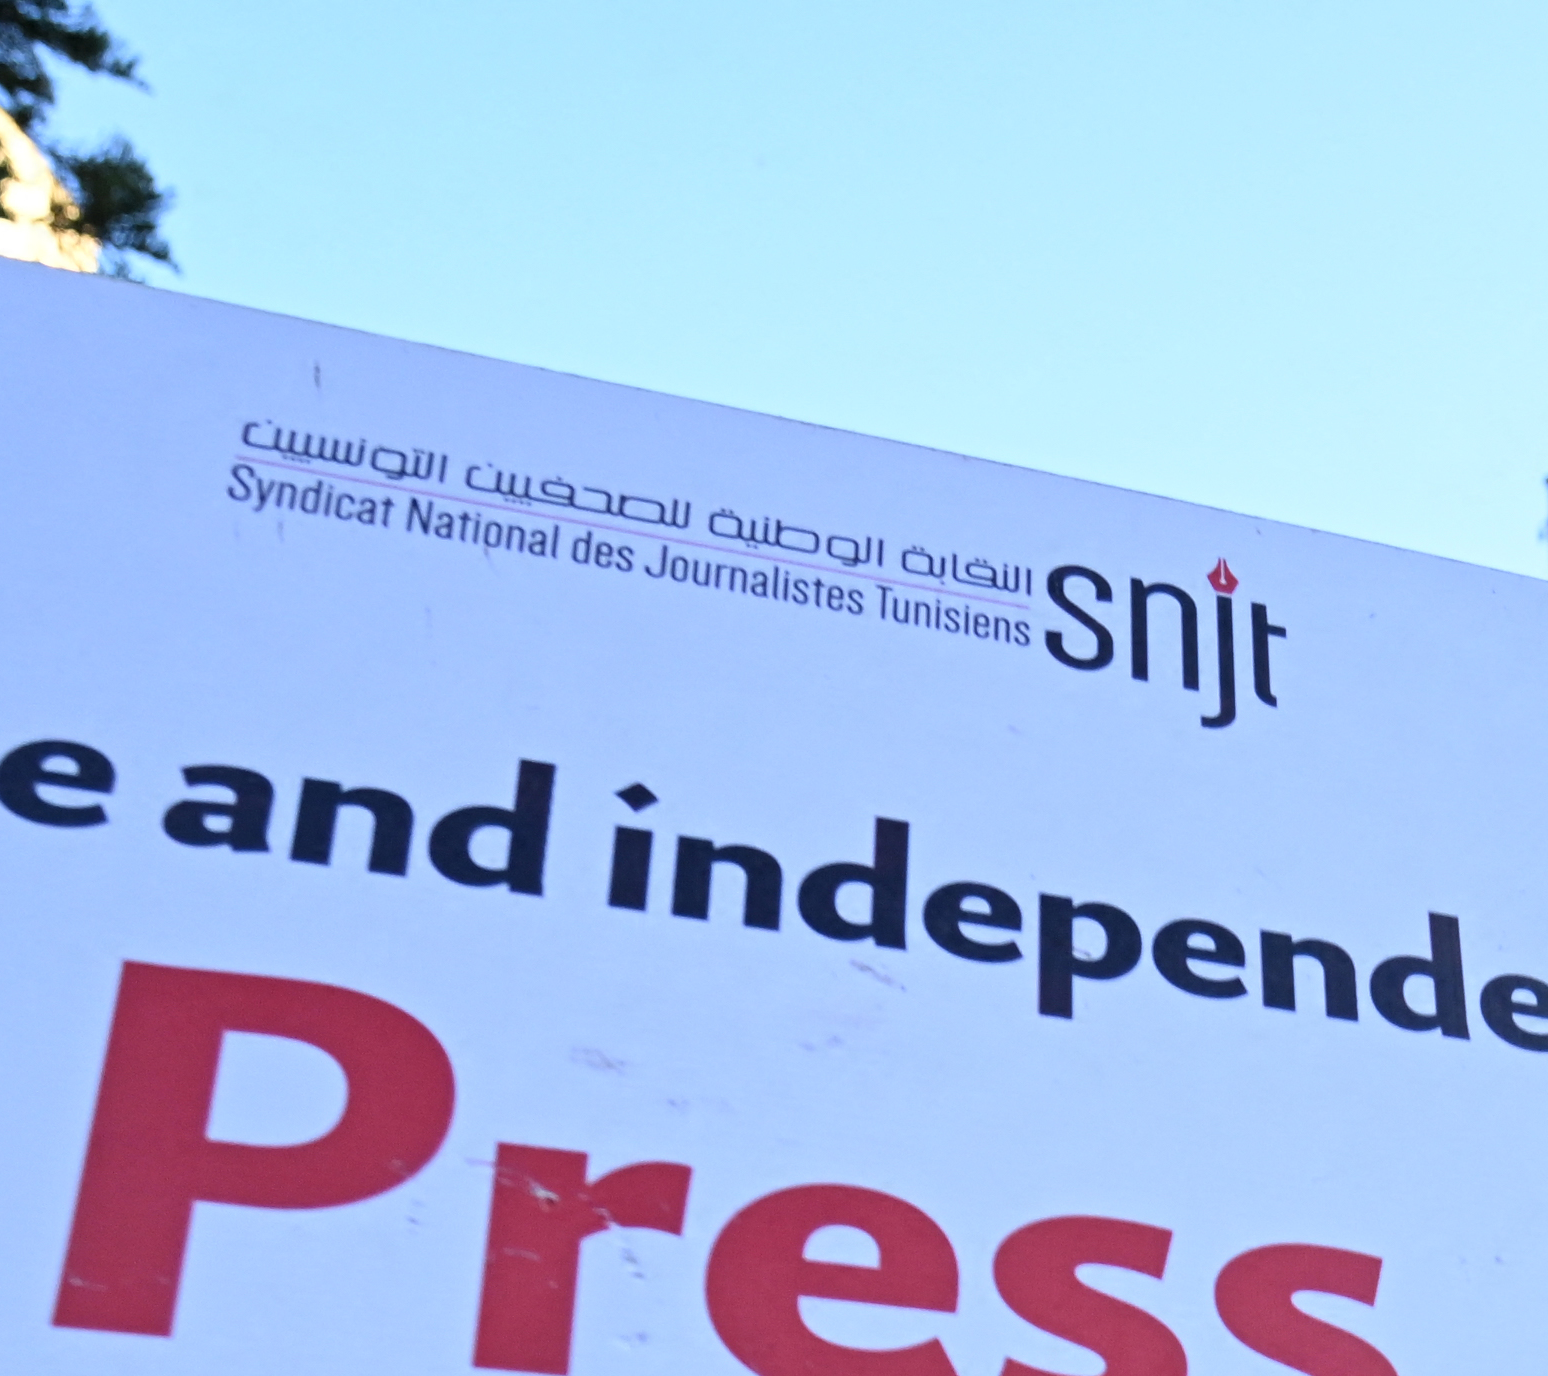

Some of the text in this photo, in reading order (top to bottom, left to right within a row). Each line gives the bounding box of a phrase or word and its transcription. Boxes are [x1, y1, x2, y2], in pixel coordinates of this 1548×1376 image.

[465, 462, 692, 529] للصحفيين
[227, 463, 1031, 647] Syndicat National des Journalistes Tunisiens
[708, 505, 885, 568] الوطنية
[900, 544, 1033, 598] النقابة
[162, 758, 556, 896] and
